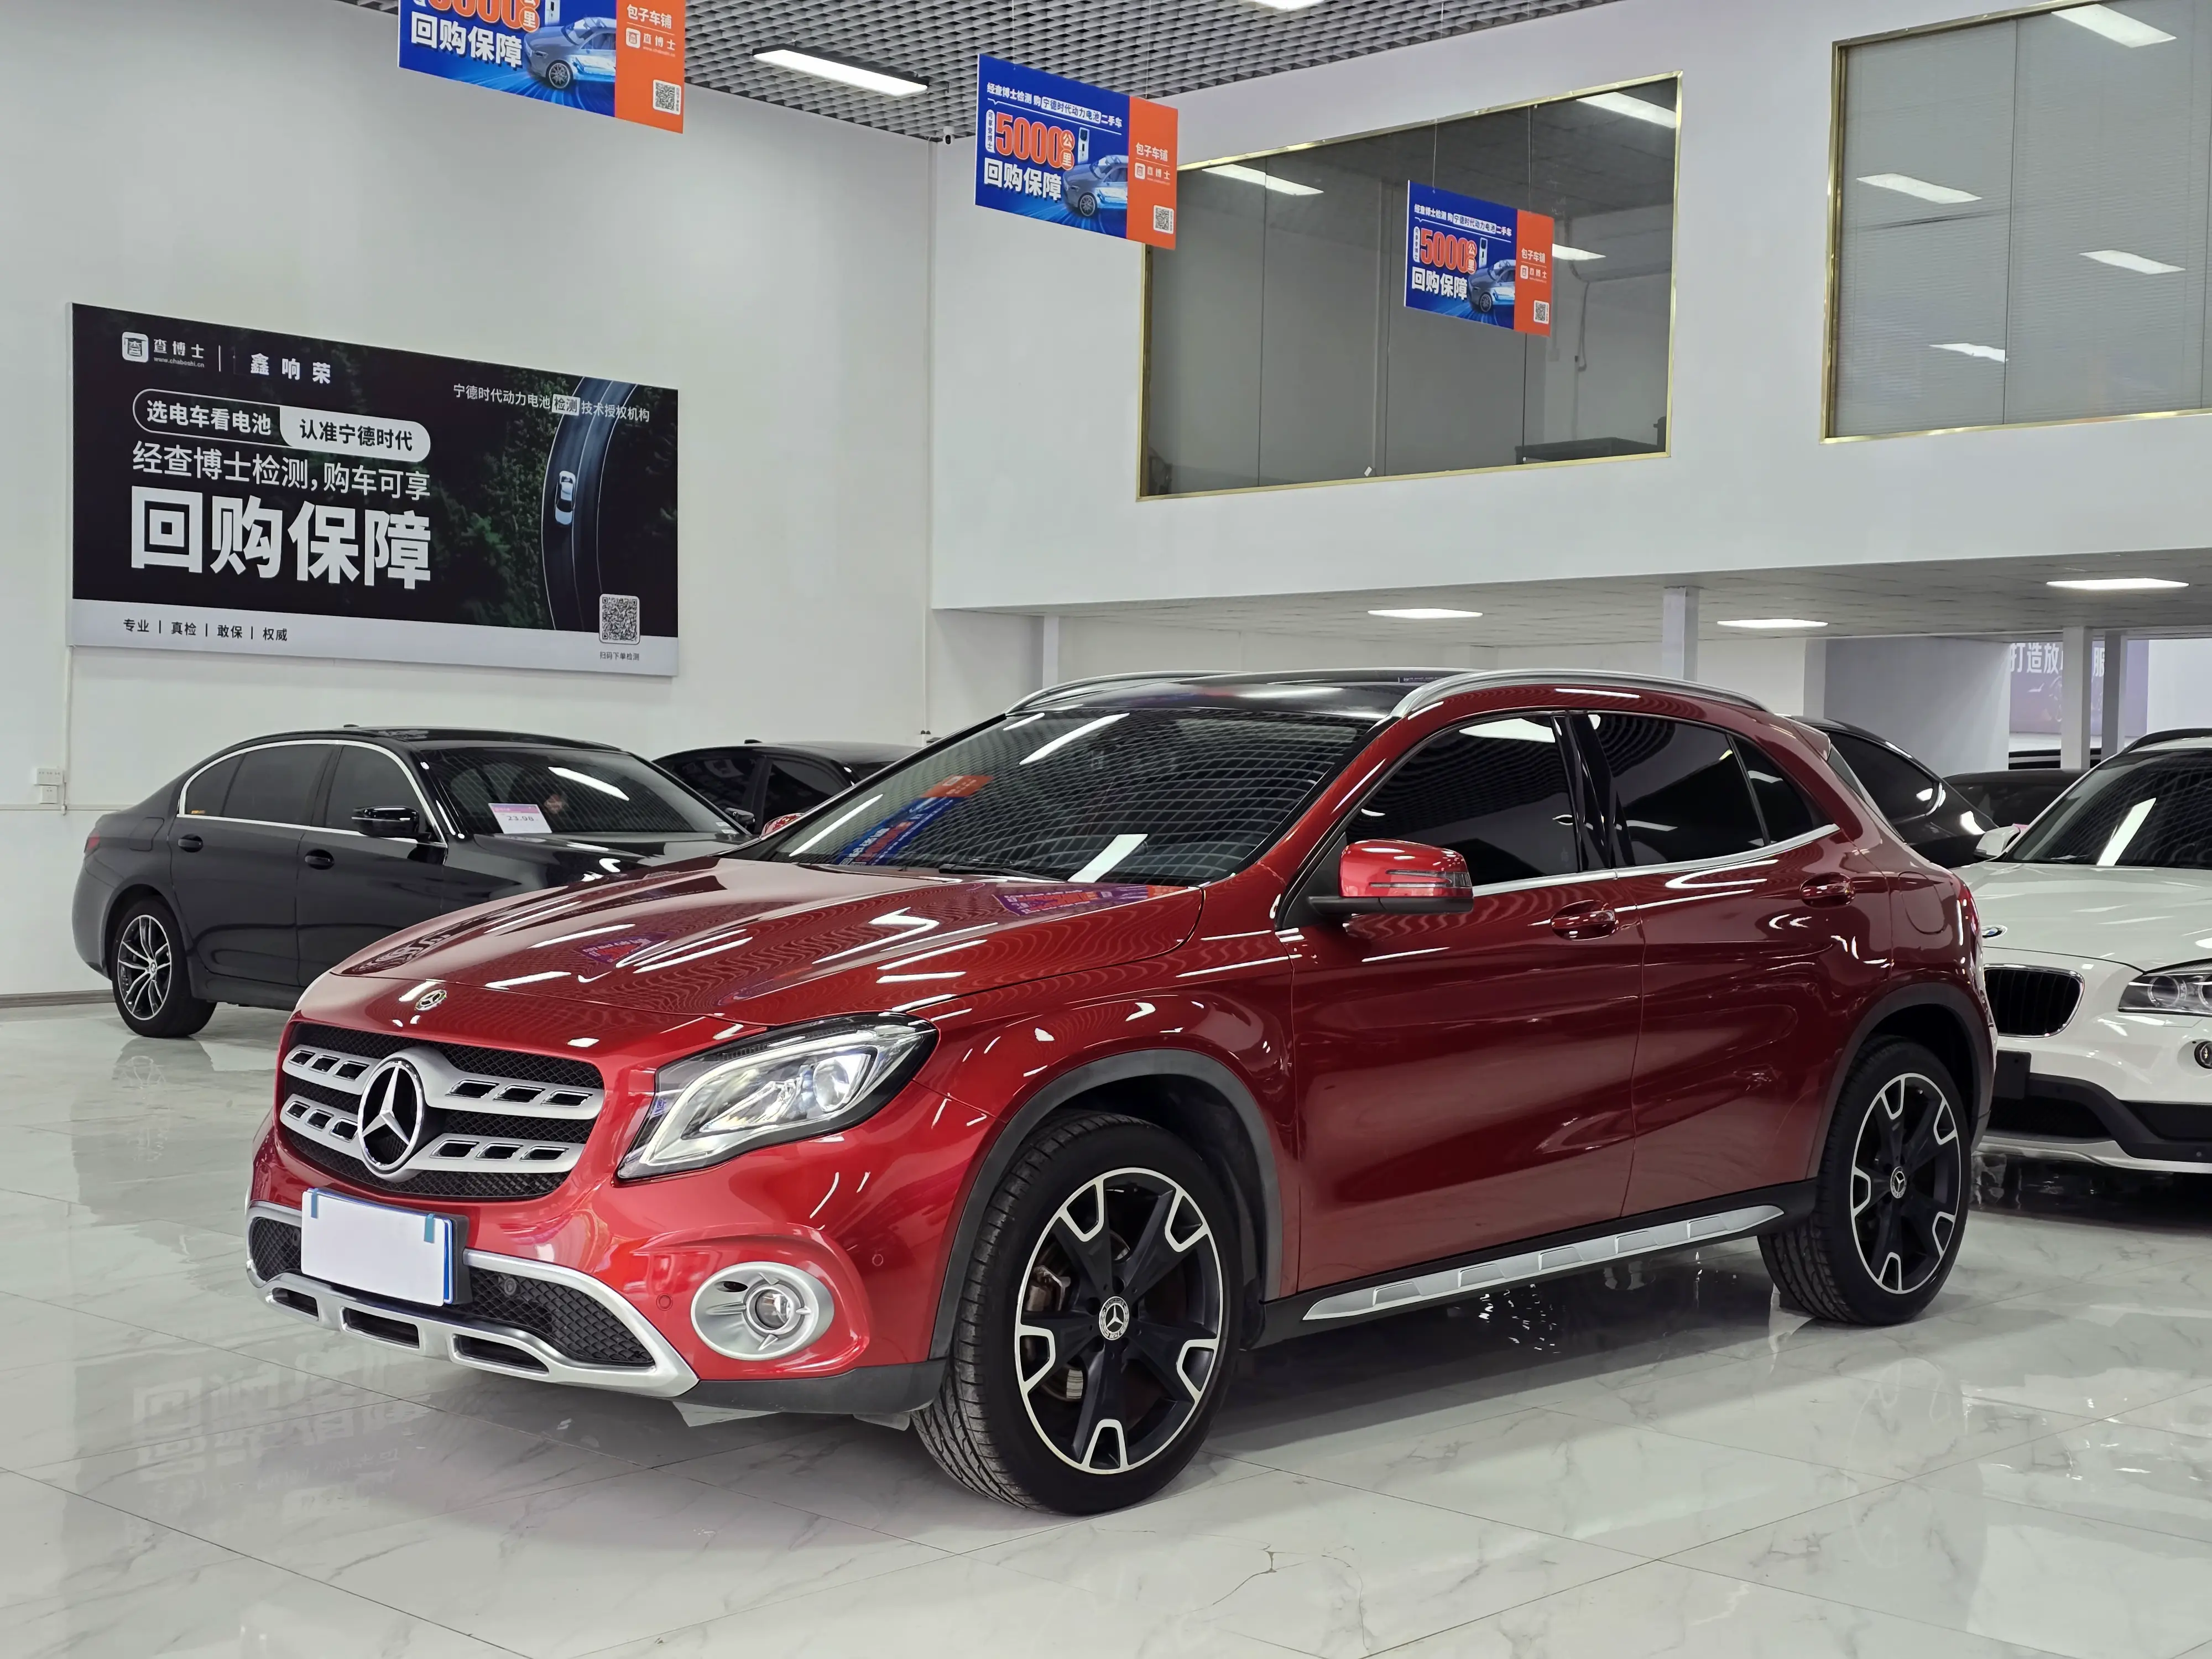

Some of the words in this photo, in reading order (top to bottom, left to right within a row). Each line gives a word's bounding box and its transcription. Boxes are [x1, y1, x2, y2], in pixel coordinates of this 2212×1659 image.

[627, 4, 671, 29] 包子车铺
[411, 11, 523, 68] 回购保障
[987, 82, 1032, 104] 经查博士检测
[1034, 95, 1123, 128] 购宁德时代动力电池二手车
[996, 112, 1063, 169] 5000
[1062, 133, 1072, 167] 公里
[1136, 142, 1168, 162] 包子车铺
[984, 157, 1062, 201] 回购保障
[1420, 227, 1468, 273] 5000
[1467, 243, 1475, 272] 公里
[1412, 266, 1468, 300] 回购保障
[154, 338, 205, 358] 查博士
[250, 352, 331, 384] 鑫响荣
[147, 399, 272, 436] 选电车看电池
[453, 382, 650, 423] 宁德时代动力电池检测技术授权机构
[299, 418, 413, 451] 认准宁德时代
[131, 486, 431, 589] 回购保障
[123, 618, 150, 633] 专业
[170, 621, 197, 637] 真检
[217, 624, 243, 639] 敢保
[262, 627, 288, 642] 权威
[599, 651, 640, 661] 扫码下单检测
[2010, 642, 2063, 675] 打造放
